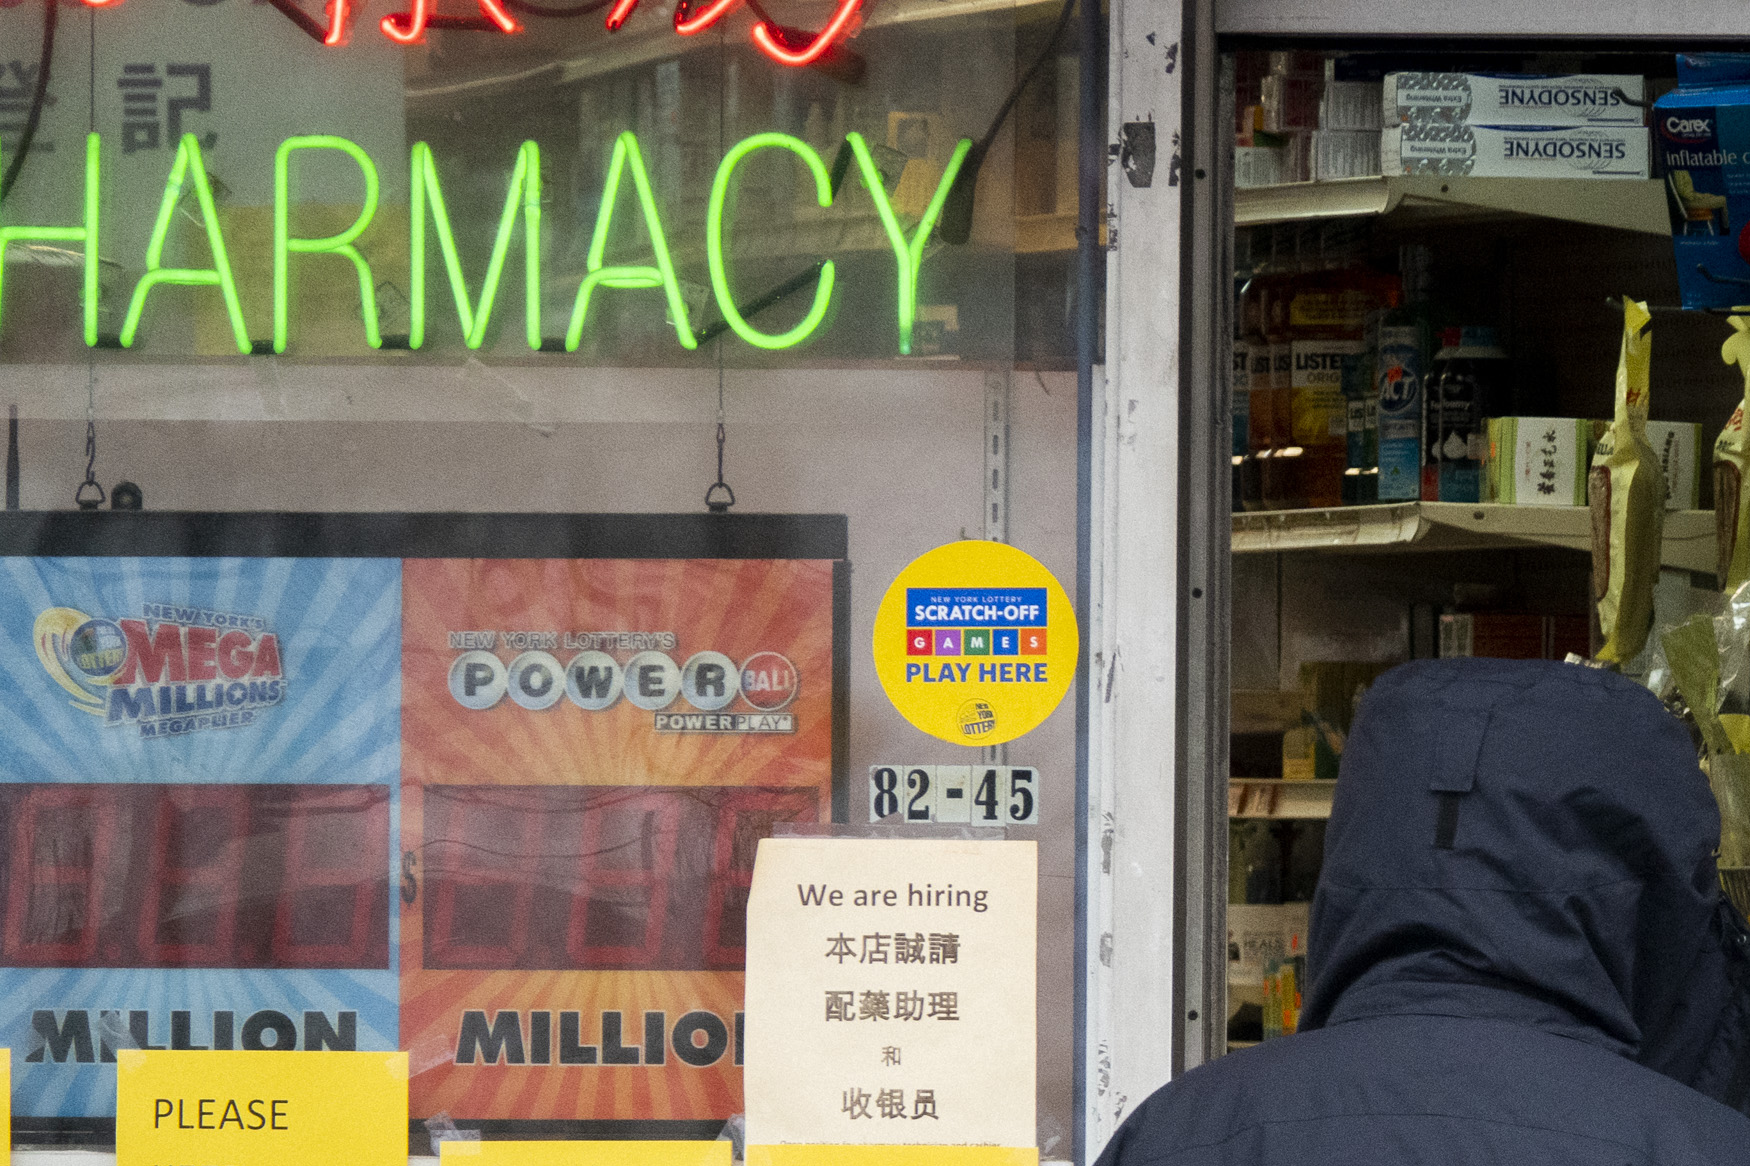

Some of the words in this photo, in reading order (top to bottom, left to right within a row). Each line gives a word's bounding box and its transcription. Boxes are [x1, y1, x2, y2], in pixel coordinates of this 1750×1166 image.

[1499, 88, 1620, 107] SENSODYNE
[1666, 115, 1711, 134] Carex
[1503, 140, 1626, 160] SENSODYNE
[1667, 149, 1737, 167] inflatable
[931, 595, 950, 603] NEW
[954, 595, 978, 603] YORK
[982, 595, 1022, 603] LOTTERY
[143, 604, 195, 622] NEW
[202, 610, 264, 630] YORK'S
[914, 604, 1040, 622] SCRATCH-OFF
[449, 631, 496, 649] NEW
[502, 631, 557, 649] YORK
[564, 631, 676, 649] LOTTERY'S
[914, 636, 1038, 649] GAMES
[113, 618, 282, 685] MEGA
[906, 663, 971, 683] PLAY
[978, 663, 1048, 683] HERE
[106, 680, 282, 722] MILLIONS
[140, 711, 254, 738] MEGAPLIER
[656, 714, 733, 730] POWER
[874, 766, 1034, 821] 82-45
[797, 884, 844, 906] We
[853, 889, 898, 906] are
[908, 883, 988, 912] hiring
[824, 932, 961, 965] 本店誠請
[824, 990, 960, 1022] 配藥助理
[881, 1045, 902, 1067] 和
[154, 1098, 289, 1130] PLEASE
[841, 1087, 940, 1121] 收银员
